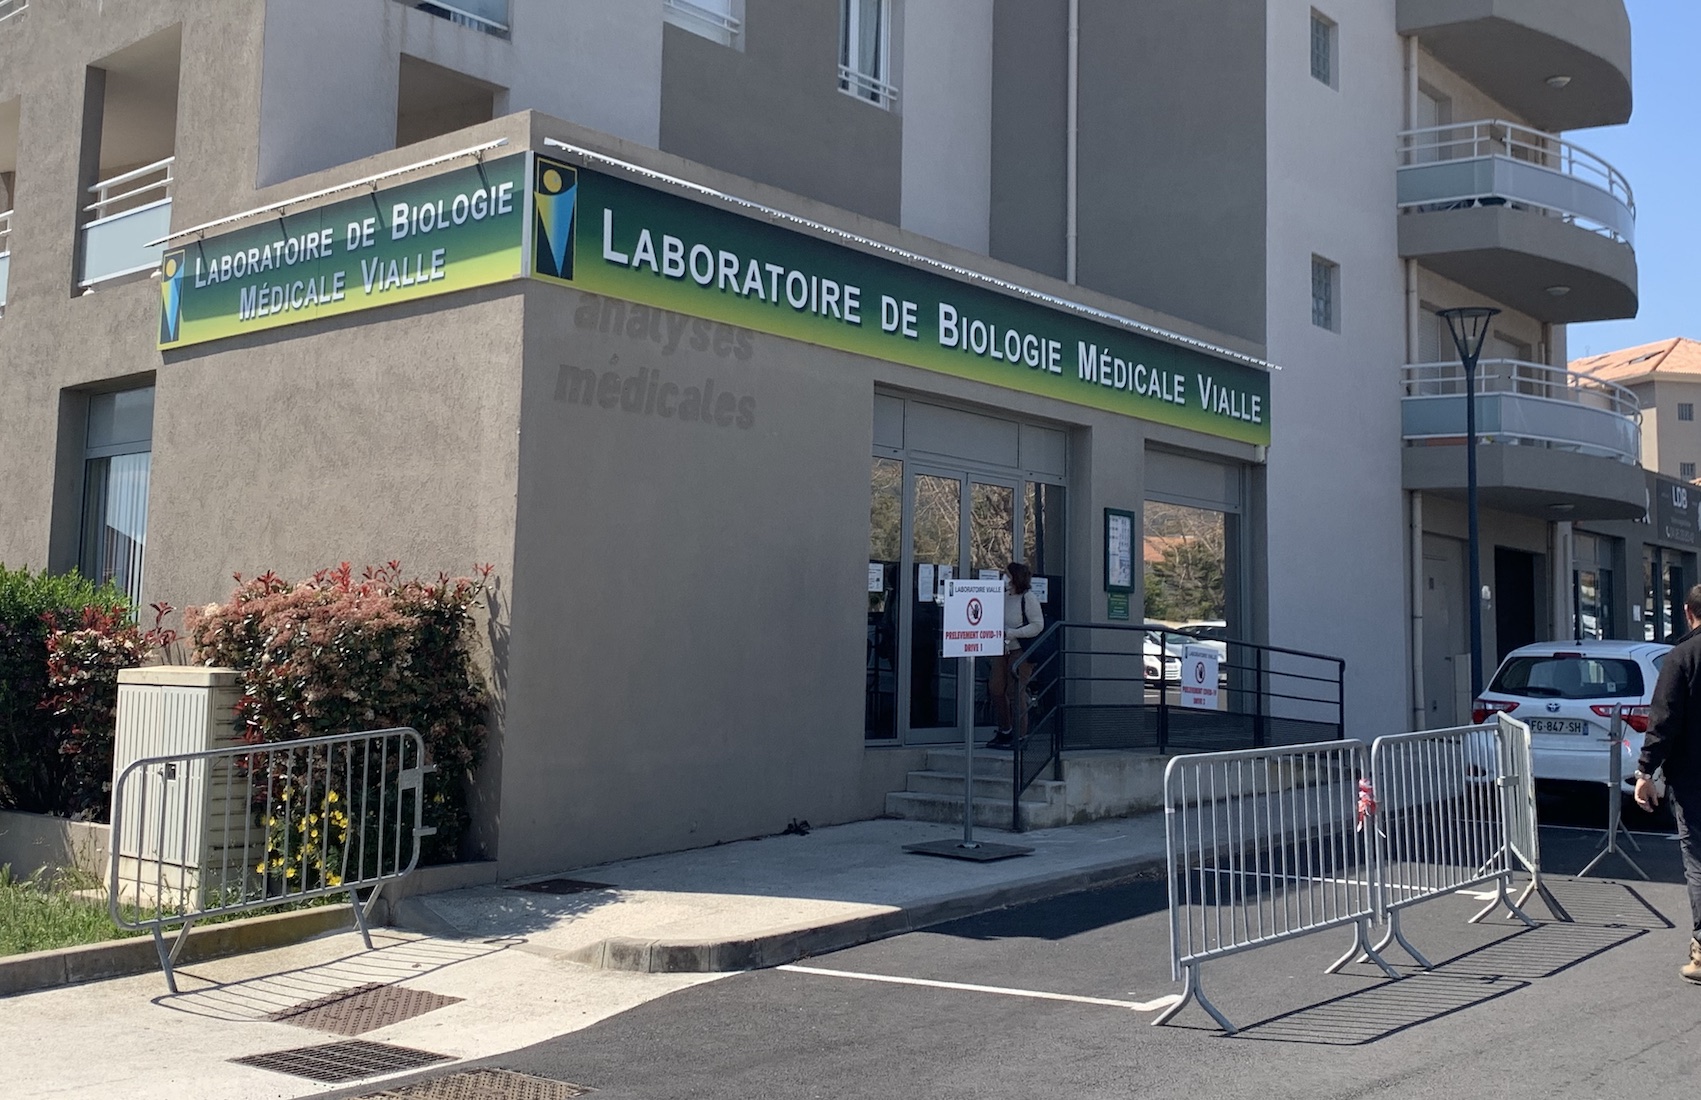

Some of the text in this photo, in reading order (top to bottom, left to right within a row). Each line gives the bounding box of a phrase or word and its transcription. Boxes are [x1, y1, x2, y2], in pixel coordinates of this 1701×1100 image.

[194, 181, 514, 288] LABORATOIRE DE BIOLOGIE
[238, 248, 446, 321] MÉDICALE VIALLE
[602, 208, 1262, 424] LABORATOIRE DE BIOLOGIE MÉDICALE VIALLE
[573, 295, 754, 360] analyses
[553, 353, 756, 431] médicales
[1672, 485, 1688, 509] LDB
[945, 630, 1002, 640] PRELEVEMENT COVID-19
[964, 643, 979, 652] DRIVE
